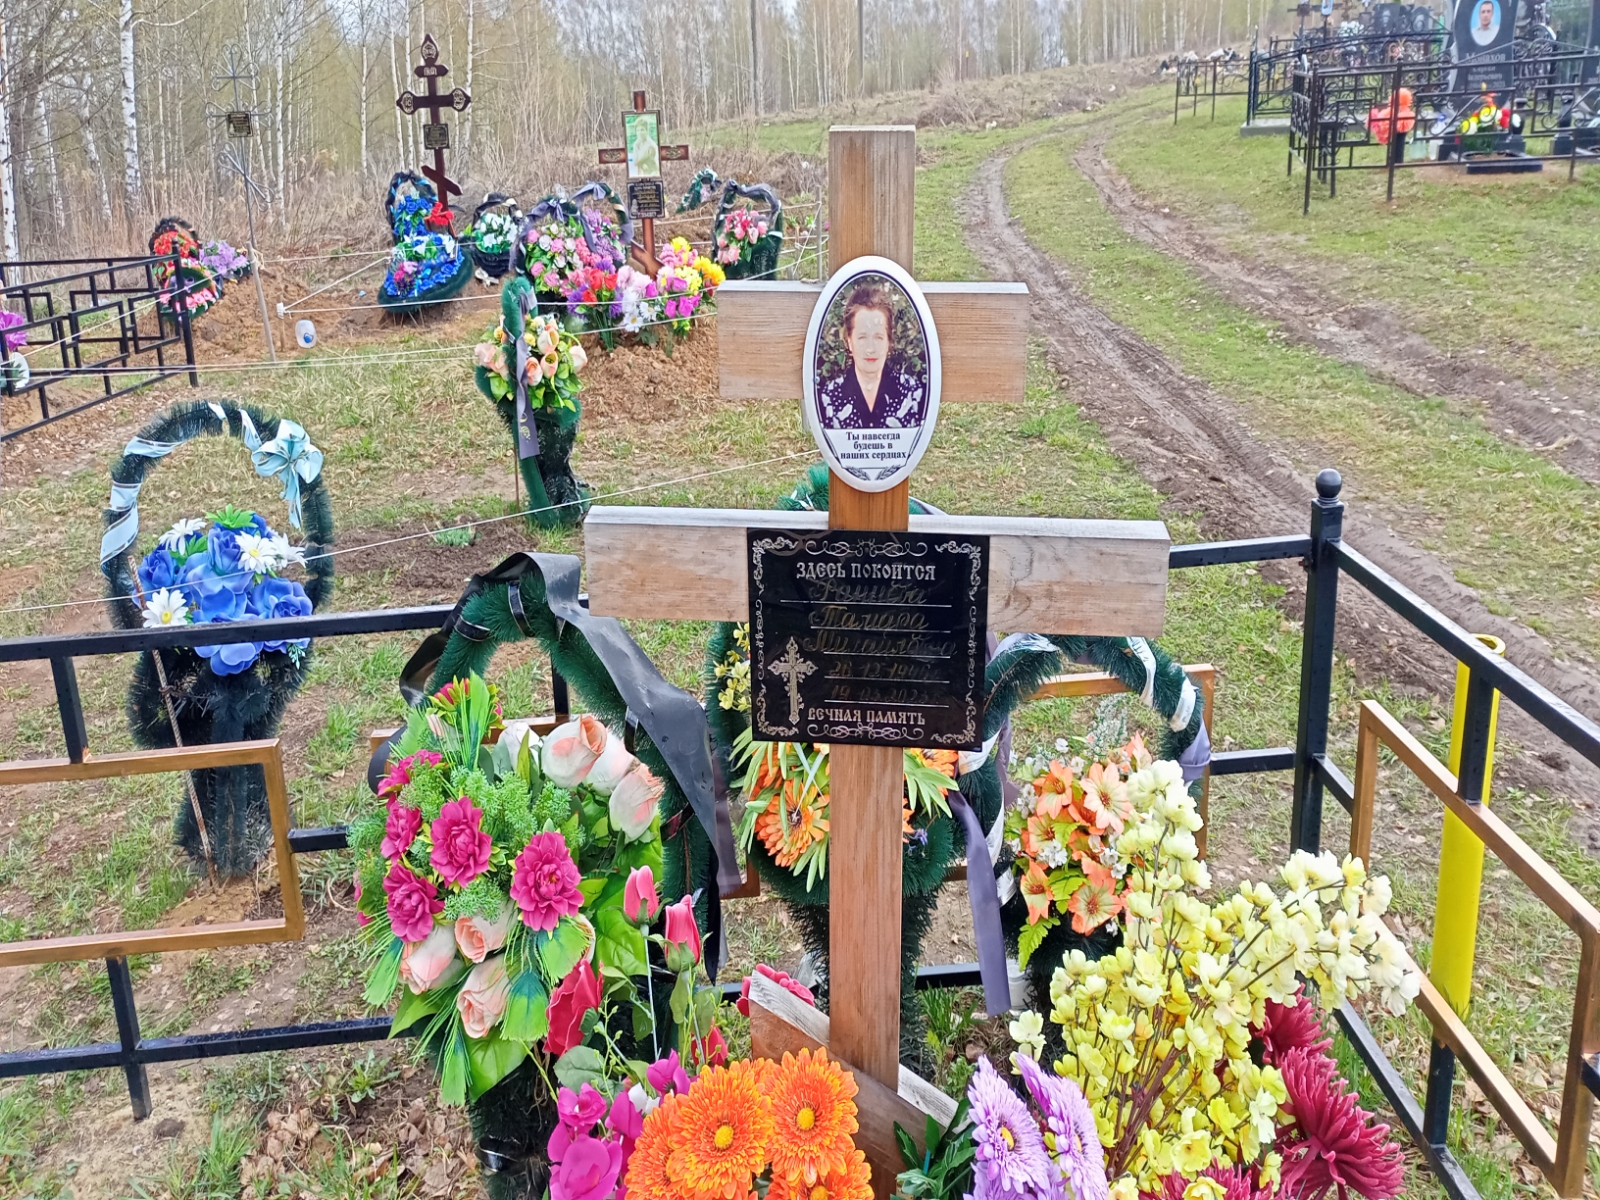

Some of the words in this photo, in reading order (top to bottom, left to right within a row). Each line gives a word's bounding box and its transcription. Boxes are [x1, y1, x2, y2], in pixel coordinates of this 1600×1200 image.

[845, 431, 860, 441] Ты
[862, 432, 901, 441] навсегда
[853, 440, 885, 452] будешь
[840, 451, 870, 460] наших
[872, 451, 907, 461] сердцах
[796, 562, 846, 580] ЗДЕСЬ
[851, 563, 936, 580] ПОКОИТСЯ
[808, 605, 930, 630] Тамара
[807, 707, 862, 722] ВЕЧНАЯ
[866, 710, 926, 725] ПАМЯТЬ
